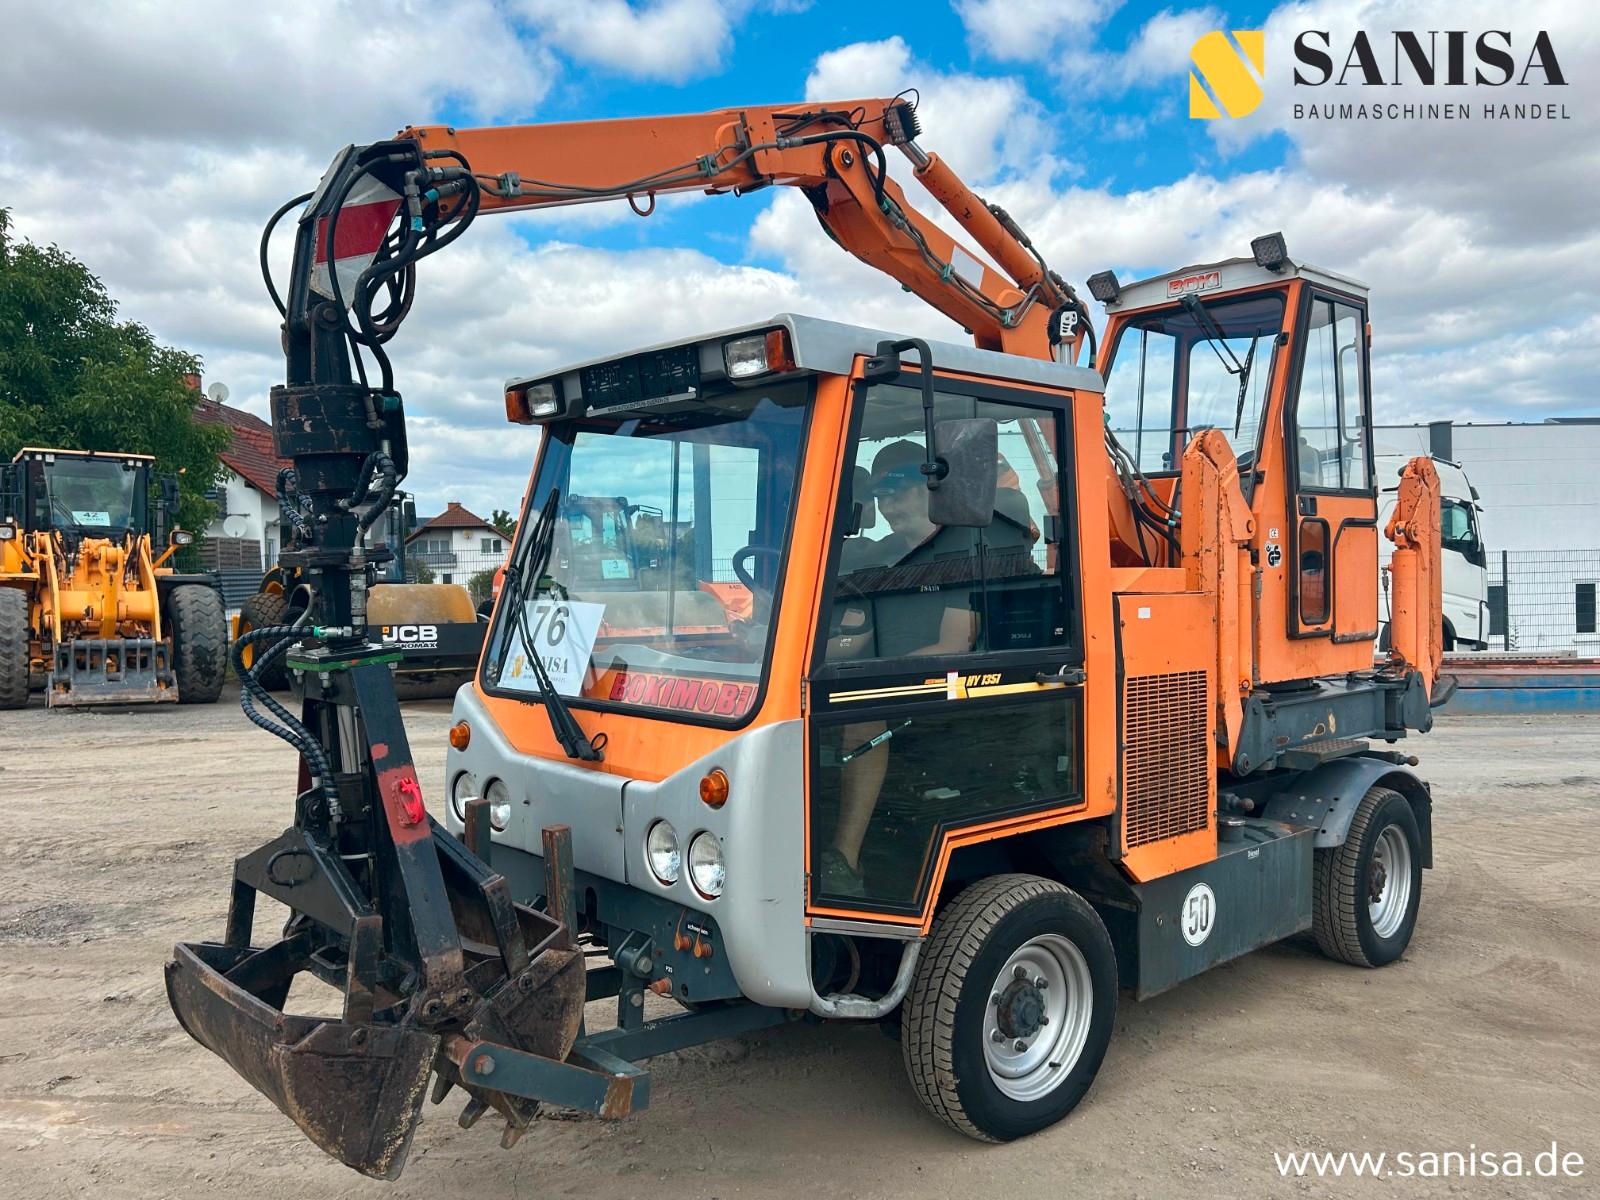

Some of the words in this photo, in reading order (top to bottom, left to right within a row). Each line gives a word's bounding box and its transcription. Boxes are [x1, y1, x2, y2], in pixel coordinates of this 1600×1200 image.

[1168, 271, 1220, 297] BOKI
[382, 625, 438, 641] JCB
[531, 605, 569, 647] 76
[1188, 893, 1210, 936] 50
